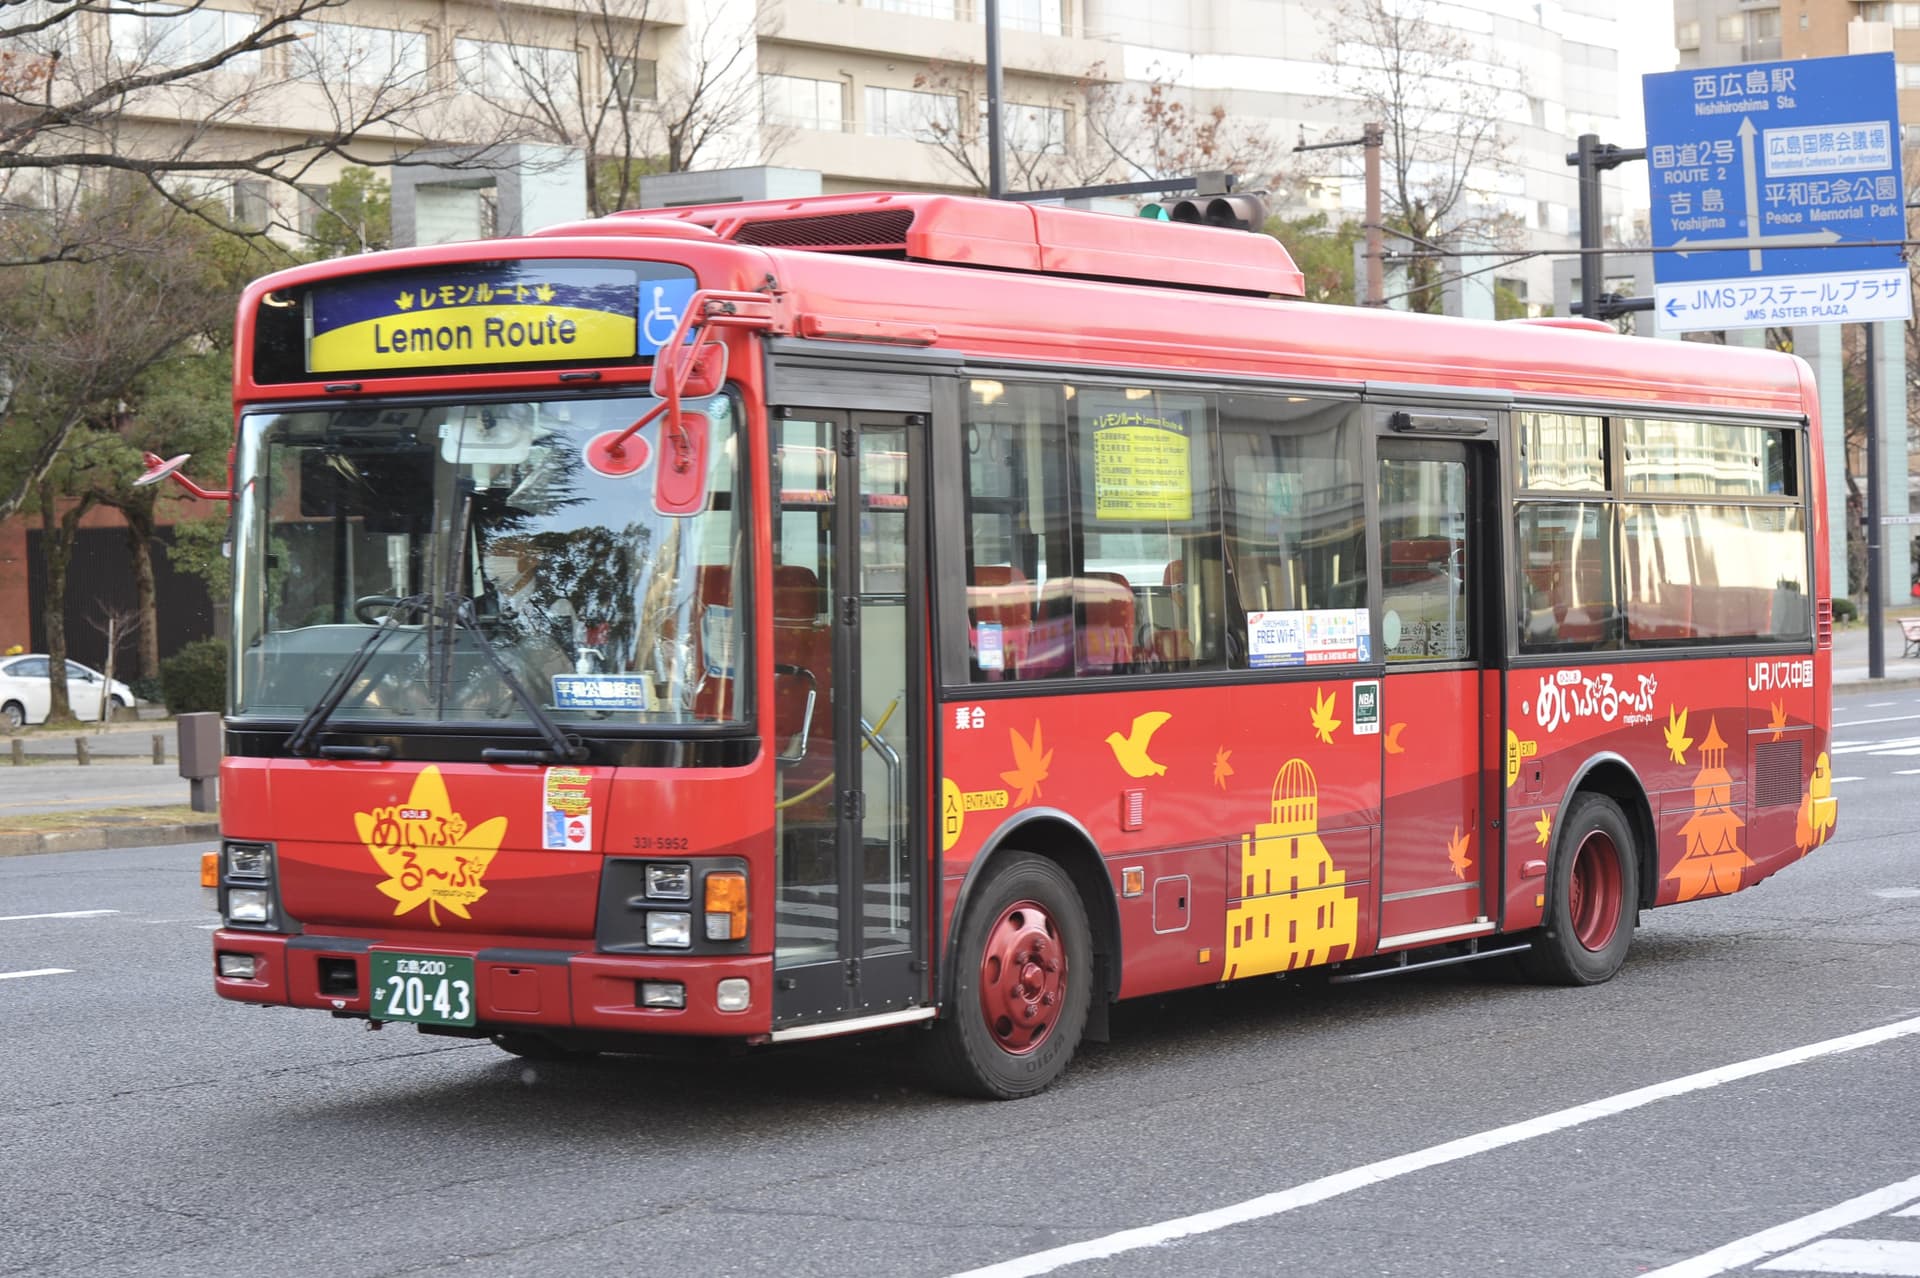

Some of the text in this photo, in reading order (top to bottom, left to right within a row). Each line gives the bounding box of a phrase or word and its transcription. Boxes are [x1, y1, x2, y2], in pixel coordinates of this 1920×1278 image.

[1693, 67, 1796, 99] 西広島駅
[1695, 96, 1797, 116] Nishihiroshima Sta.
[1769, 128, 1886, 156] 広島国際会議場
[1652, 139, 1735, 169] 国道2号
[1664, 168, 1727, 184] ROUTE 2
[1764, 176, 1897, 208] 平和記念公園
[1671, 217, 1726, 231] Yoshijima
[1765, 203, 1898, 225] Peace Memorial Park
[420, 282, 530, 307] レモンルート
[1691, 279, 1902, 311] JMSアステールプラザ
[1744, 304, 1848, 321] JMS ASTER PLAZA
[374, 314, 577, 354] Lemon Route
[1099, 412, 1142, 428] レモンルート
[1257, 628, 1296, 644] FREE Wi-Fi
[1748, 659, 1813, 692] JRバス中国
[1358, 692, 1375, 705] NBA
[955, 706, 986, 729] 乗合
[1509, 742, 1517, 775] 出口
[1521, 742, 1535, 755] EXIT
[966, 792, 1004, 809] ENTRANCE
[945, 794, 958, 834] 入口
[633, 836, 689, 850] 331-5952
[387, 976, 470, 1020] 20-43
